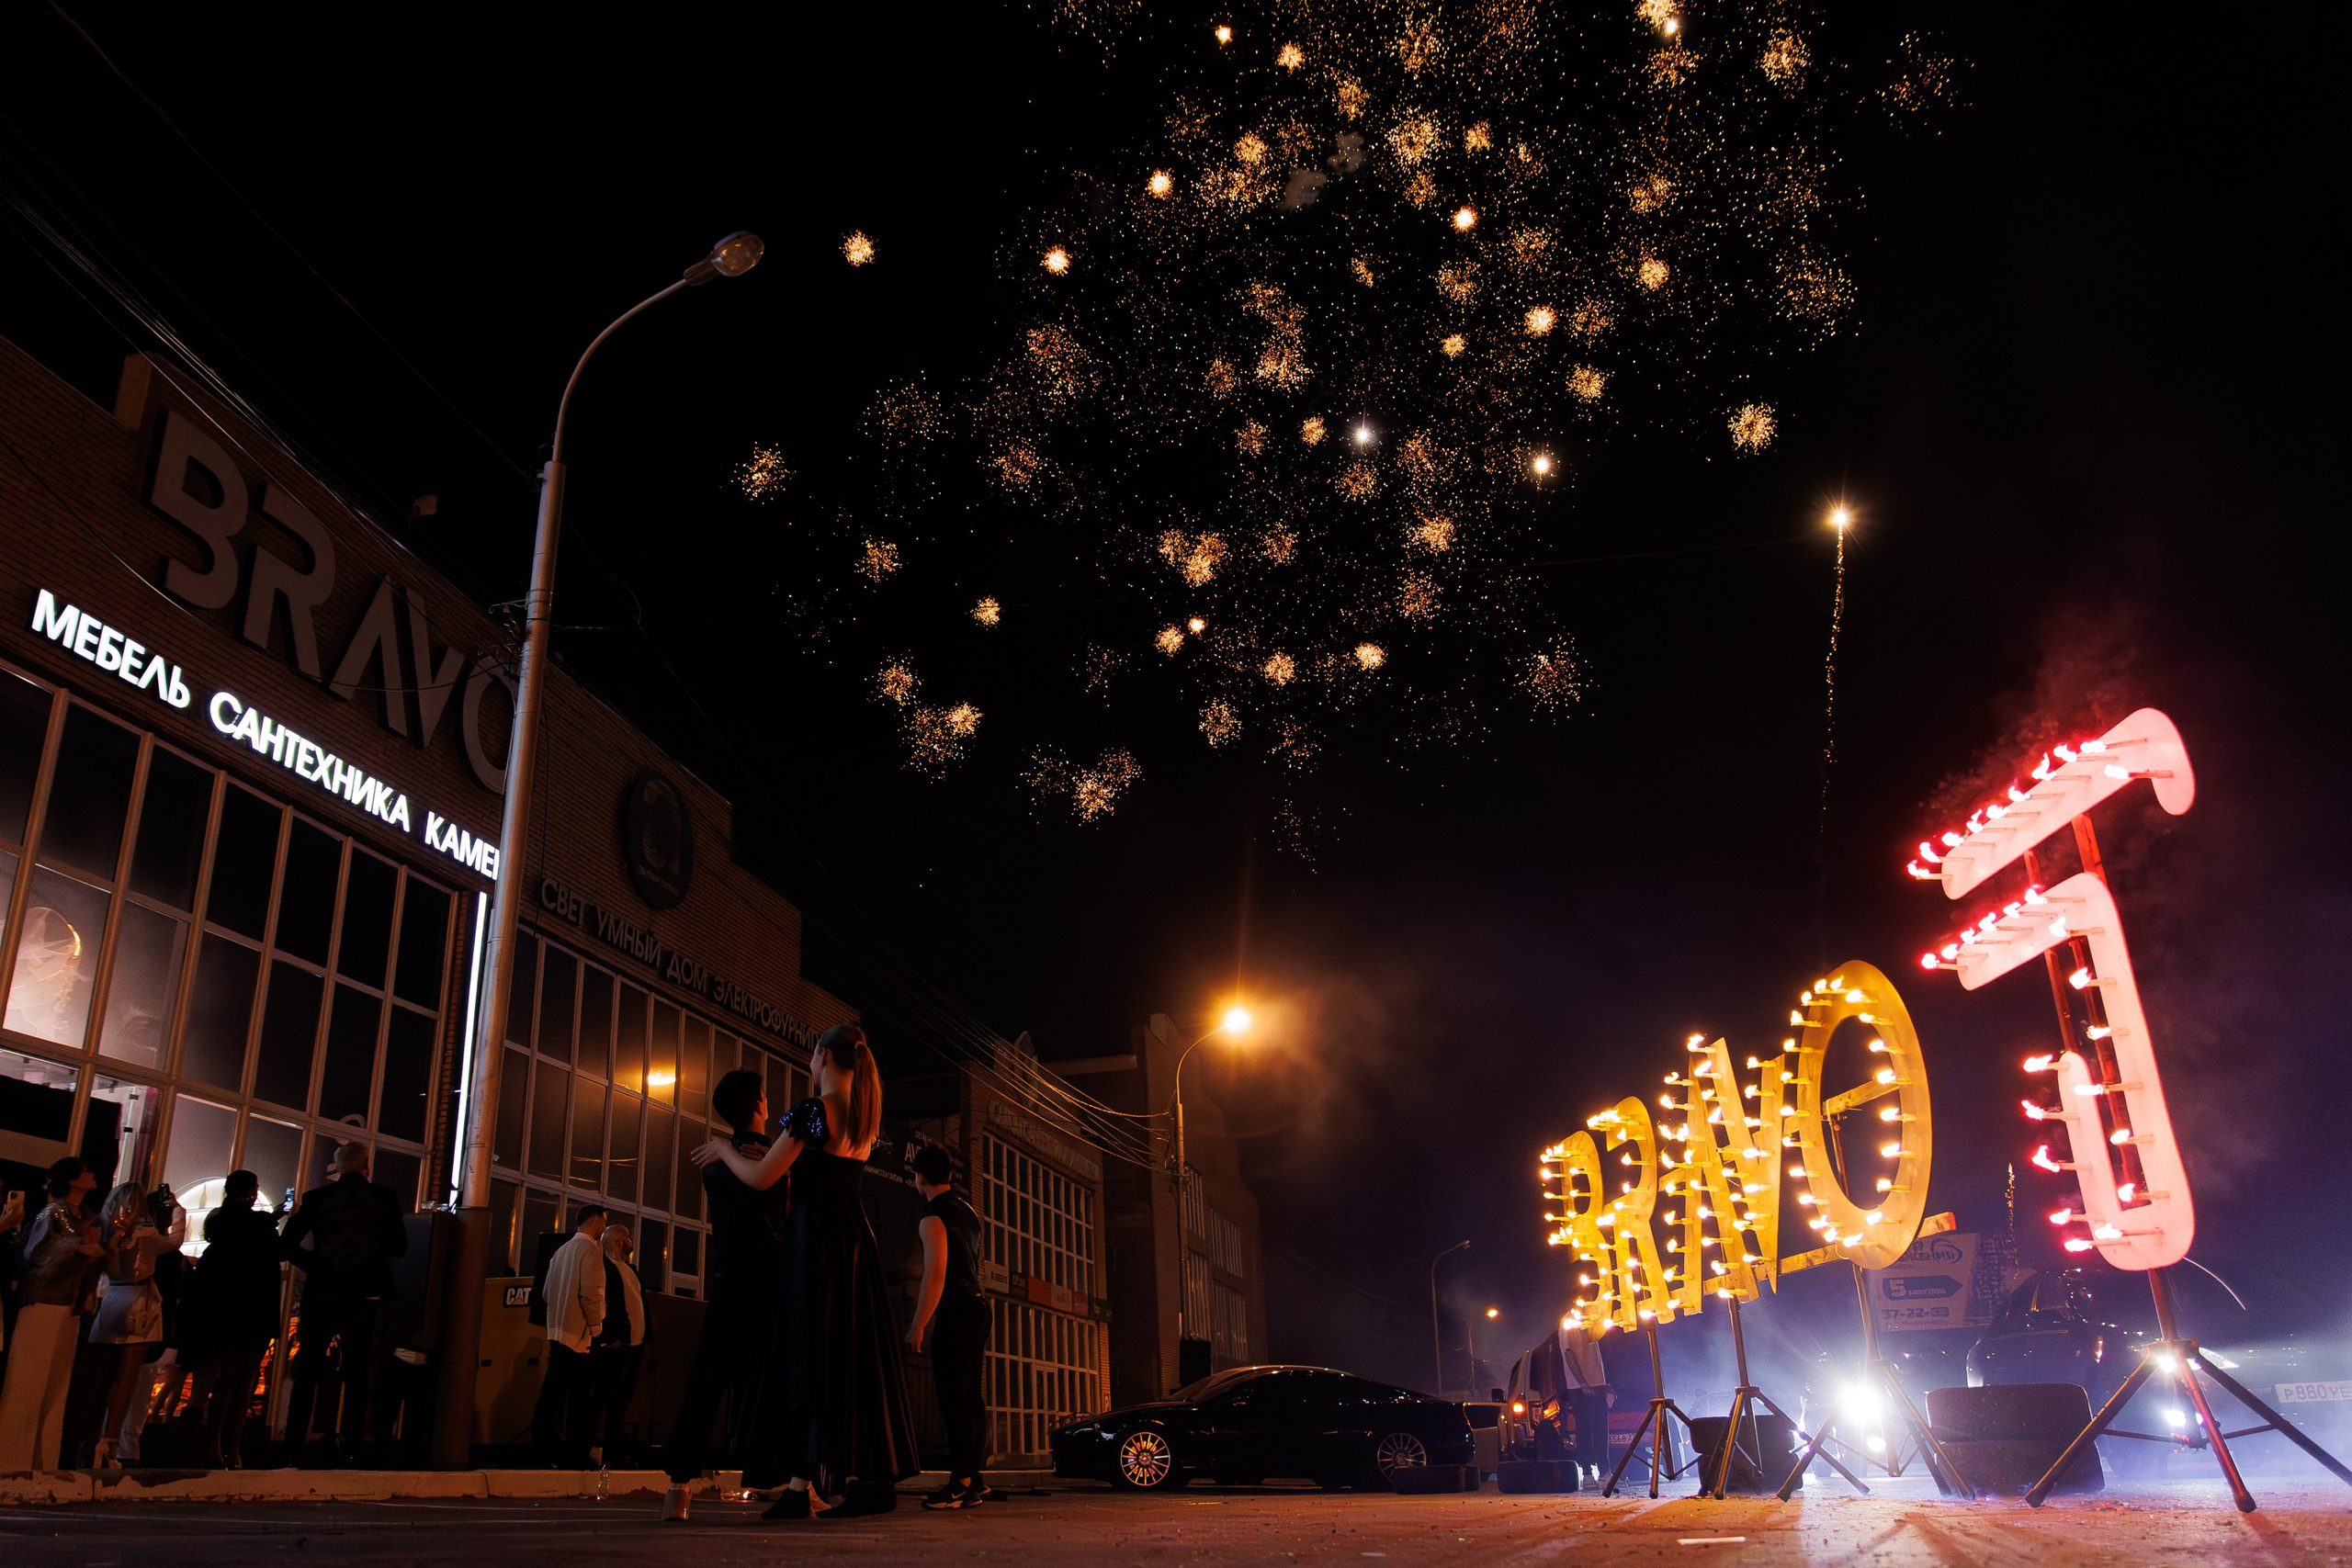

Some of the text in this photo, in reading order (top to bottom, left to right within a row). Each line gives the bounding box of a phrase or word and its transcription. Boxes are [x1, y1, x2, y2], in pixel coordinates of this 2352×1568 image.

[31, 588, 500, 881] МЕБЕЛЬ САНТЕХНИКА КАМЕ
[541, 878, 589, 928] СВЕТ
[596, 904, 662, 969] УМНЫЙ
[666, 952, 707, 994] ДОМ
[506, 1287, 532, 1304] CAT
